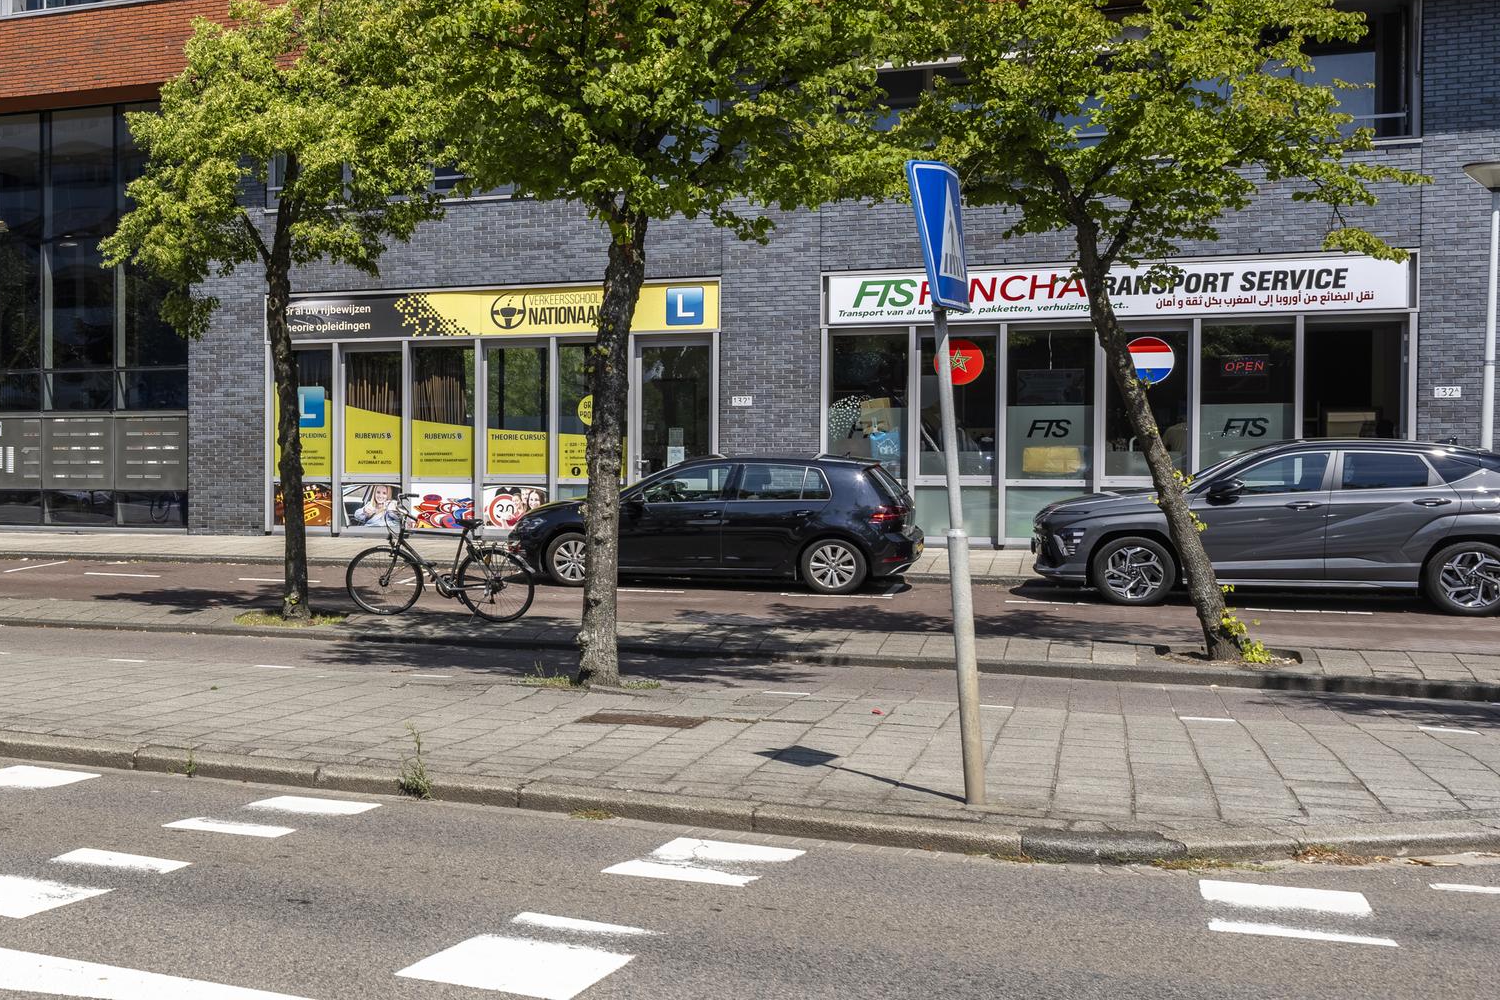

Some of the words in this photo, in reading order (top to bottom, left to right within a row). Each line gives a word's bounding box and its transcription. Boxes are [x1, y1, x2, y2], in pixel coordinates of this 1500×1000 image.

[1105, 272, 1234, 296] RANSPORT
[1240, 268, 1349, 292] SERVICE
[528, 293, 601, 306] VERKEERSSCHOOL
[852, 279, 918, 308] FTS
[1276, 290, 1301, 306] أوروبا
[1304, 292, 1318, 304] من
[1320, 291, 1353, 305] البضائع
[1356, 290, 1374, 303] نقل
[676, 294, 695, 318] L
[1156, 294, 1175, 309] أمان
[1185, 295, 1203, 306] ثقة
[1204, 296, 1221, 308] بكل
[1224, 295, 1256, 307] المغرب
[1258, 294, 1273, 307] إلى
[295, 306, 304, 315] al
[305, 307, 319, 315] uw
[321, 305, 371, 317] rijbewijzen
[839, 308, 883, 318] Transport
[978, 303, 1033, 314] pakketten,
[1037, 302, 1091, 312] verhuizing
[287, 322, 315, 332] heorie
[316, 321, 371, 333] opleidingen
[1224, 360, 1265, 372] OPEN
[1026, 419, 1072, 438] FTS
[1221, 417, 1270, 438] FTS
[424, 432, 455, 440] RIJBEWIJS
